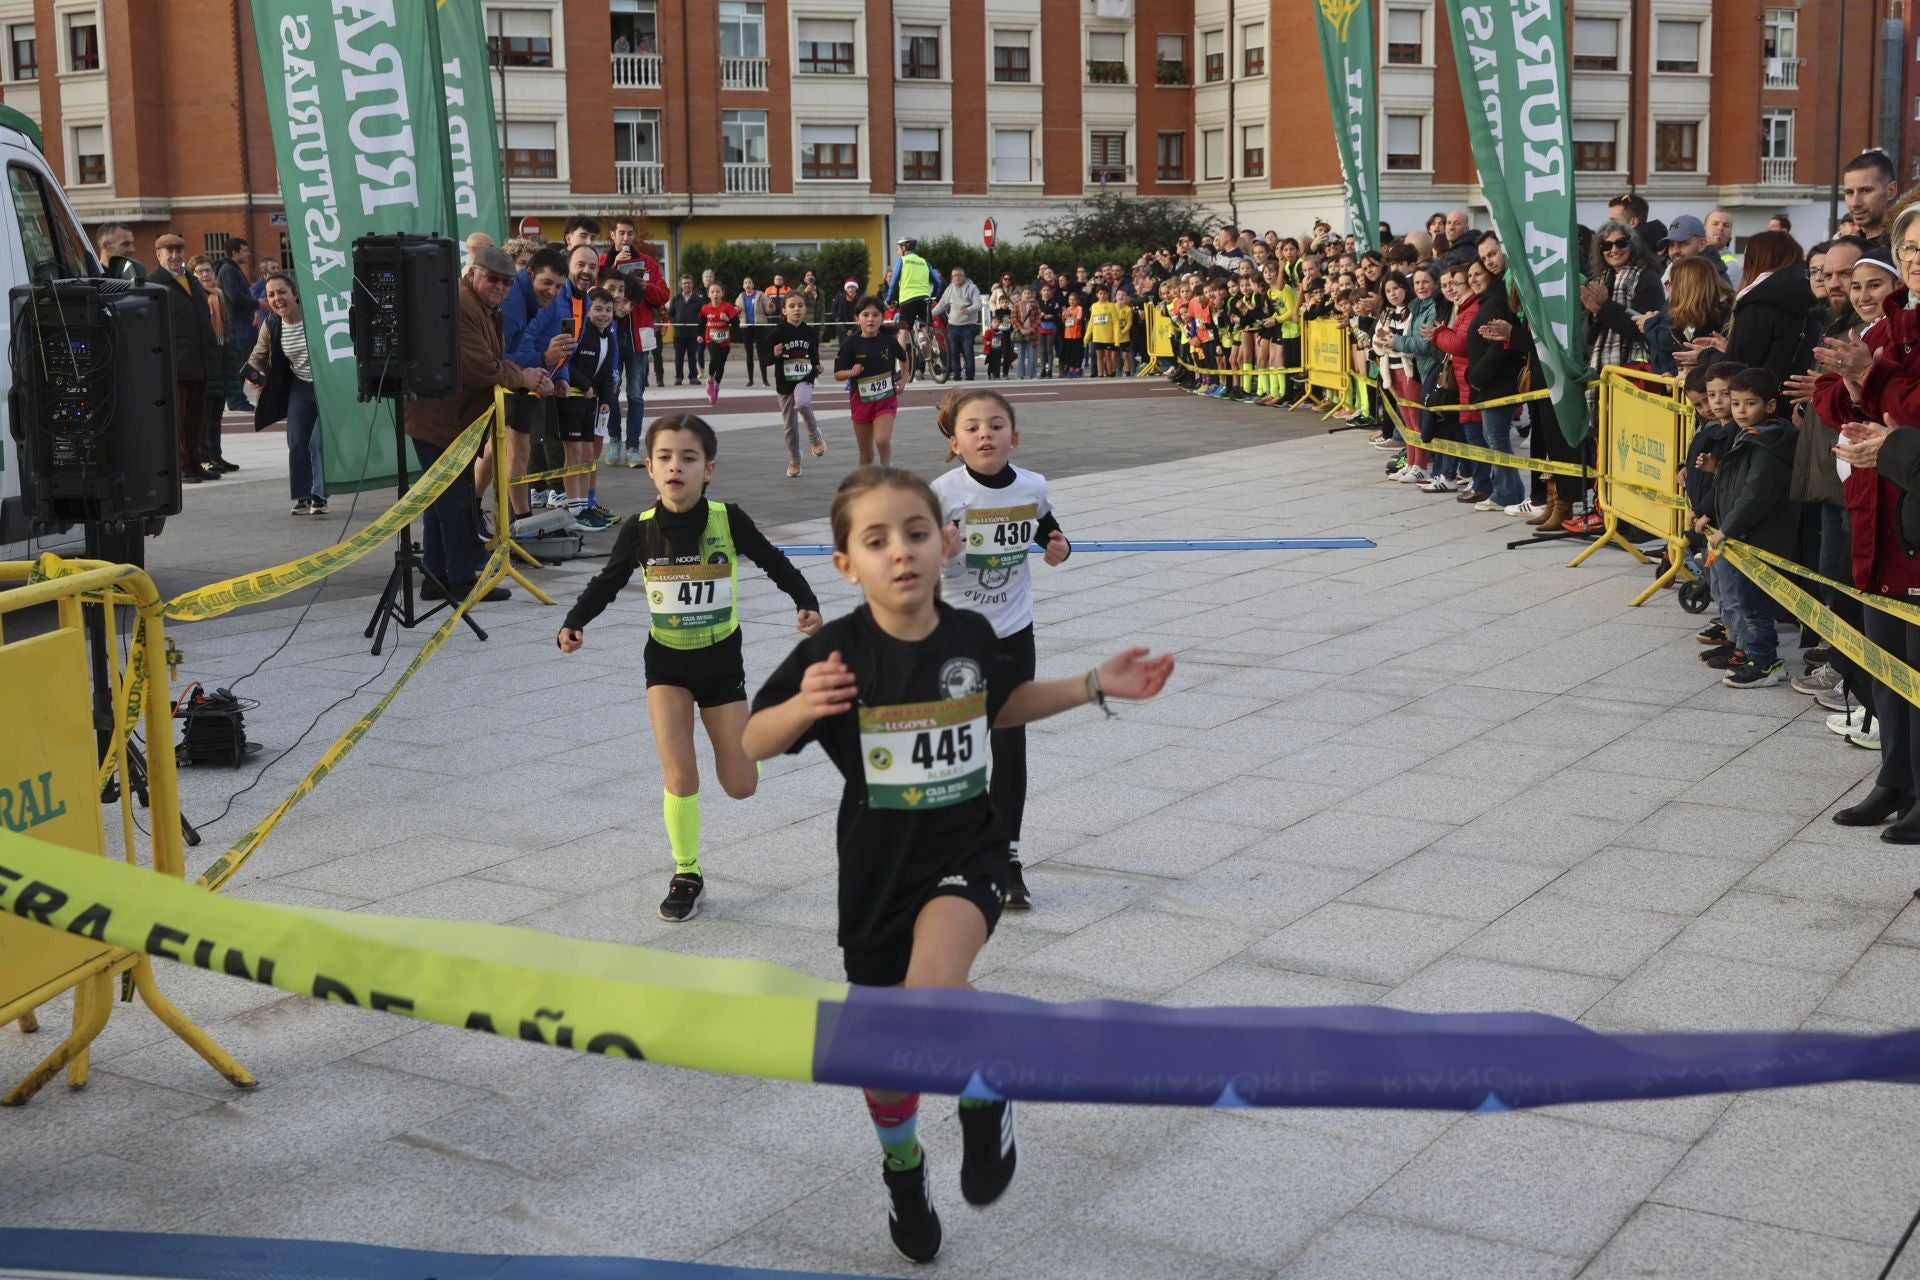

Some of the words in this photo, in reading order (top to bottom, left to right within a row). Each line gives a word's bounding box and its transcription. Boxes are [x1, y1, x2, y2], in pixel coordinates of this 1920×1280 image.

[870, 380, 888, 393] 429
[1631, 433, 1646, 456] CAJA
[1647, 438, 1666, 463] RURAL
[993, 521, 1031, 546] 430
[677, 581, 715, 605] 477
[885, 718, 937, 731] LUGONES
[911, 723, 973, 769] 445
